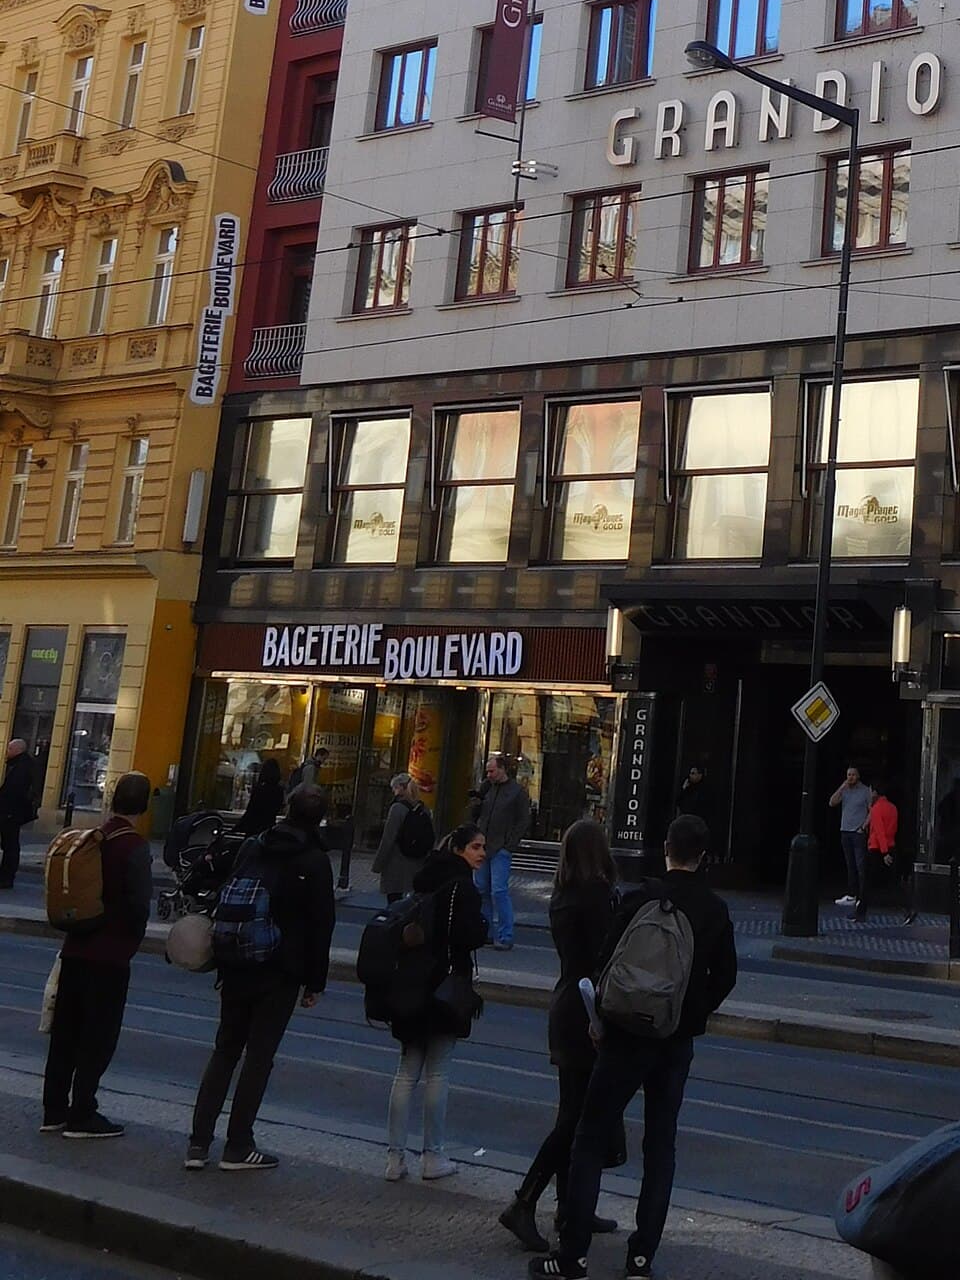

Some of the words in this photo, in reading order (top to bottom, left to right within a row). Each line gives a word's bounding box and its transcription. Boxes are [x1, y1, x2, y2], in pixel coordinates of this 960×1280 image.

[195, 308, 222, 398] BAGETERIE
[213, 217, 236, 308] BOULEVARD
[602, 522, 623, 530] GOLD
[873, 515, 899, 524] GOLD
[262, 623, 384, 667] BAGETERIE
[384, 631, 523, 680] BOULEVARD
[626, 709, 648, 826] GRANDIOR
[617, 830, 644, 841] HOTEL
